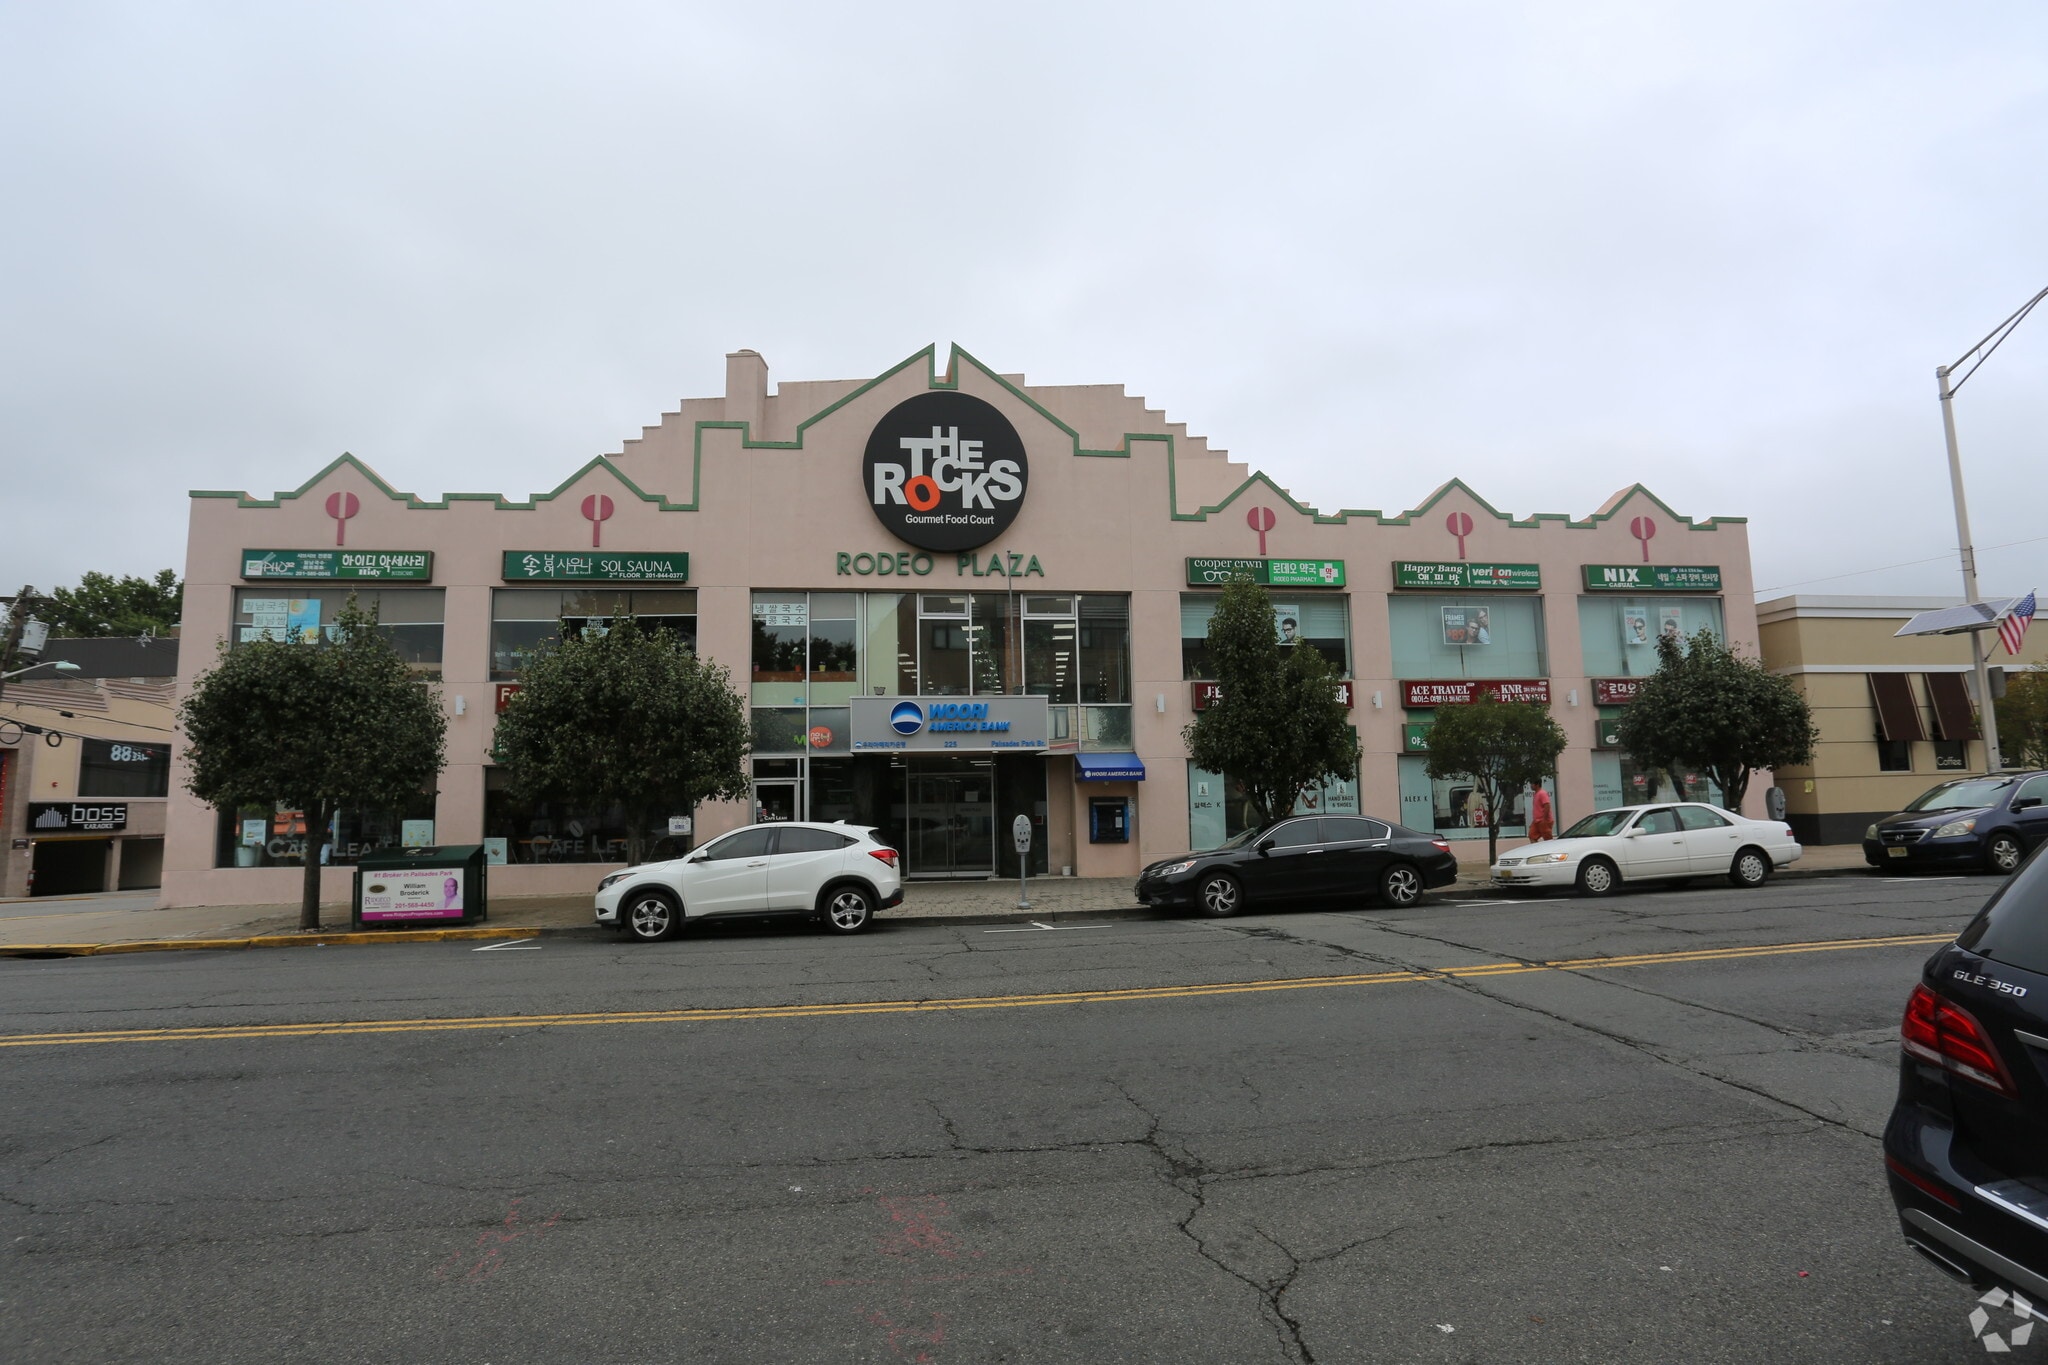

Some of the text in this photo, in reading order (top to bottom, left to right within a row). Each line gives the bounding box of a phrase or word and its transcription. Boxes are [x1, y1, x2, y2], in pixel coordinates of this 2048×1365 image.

[900, 426, 984, 478] THE
[874, 457, 1023, 511] ROCKS
[905, 514, 994, 525] Gourmet Food Court
[342, 554, 425, 572] 하이디 악세사리
[522, 554, 541, 576] 솔
[556, 557, 593, 574] 사우나
[600, 560, 673, 572] SOL SAUNA
[837, 551, 1045, 577] RODEO PLAZA
[1194, 559, 1234, 570] cooper
[1273, 562, 1317, 575] 로데오 약국
[1404, 564, 1463, 574] Happy Bang
[1472, 566, 1539, 578] verizon wireless
[1604, 568, 1640, 582] NIX
[1411, 685, 1470, 695] ACE TRAVEL
[1501, 684, 1522, 694] KNR
[1411, 695, 1430, 703] 에이스
[929, 704, 989, 720] WOORI
[928, 722, 1011, 732] AMERICA BANK
[110, 744, 132, 761] 88
[1936, 756, 1962, 766] Coffee
[71, 804, 126, 822] boss
[1953, 970, 2027, 998] GLE 350
